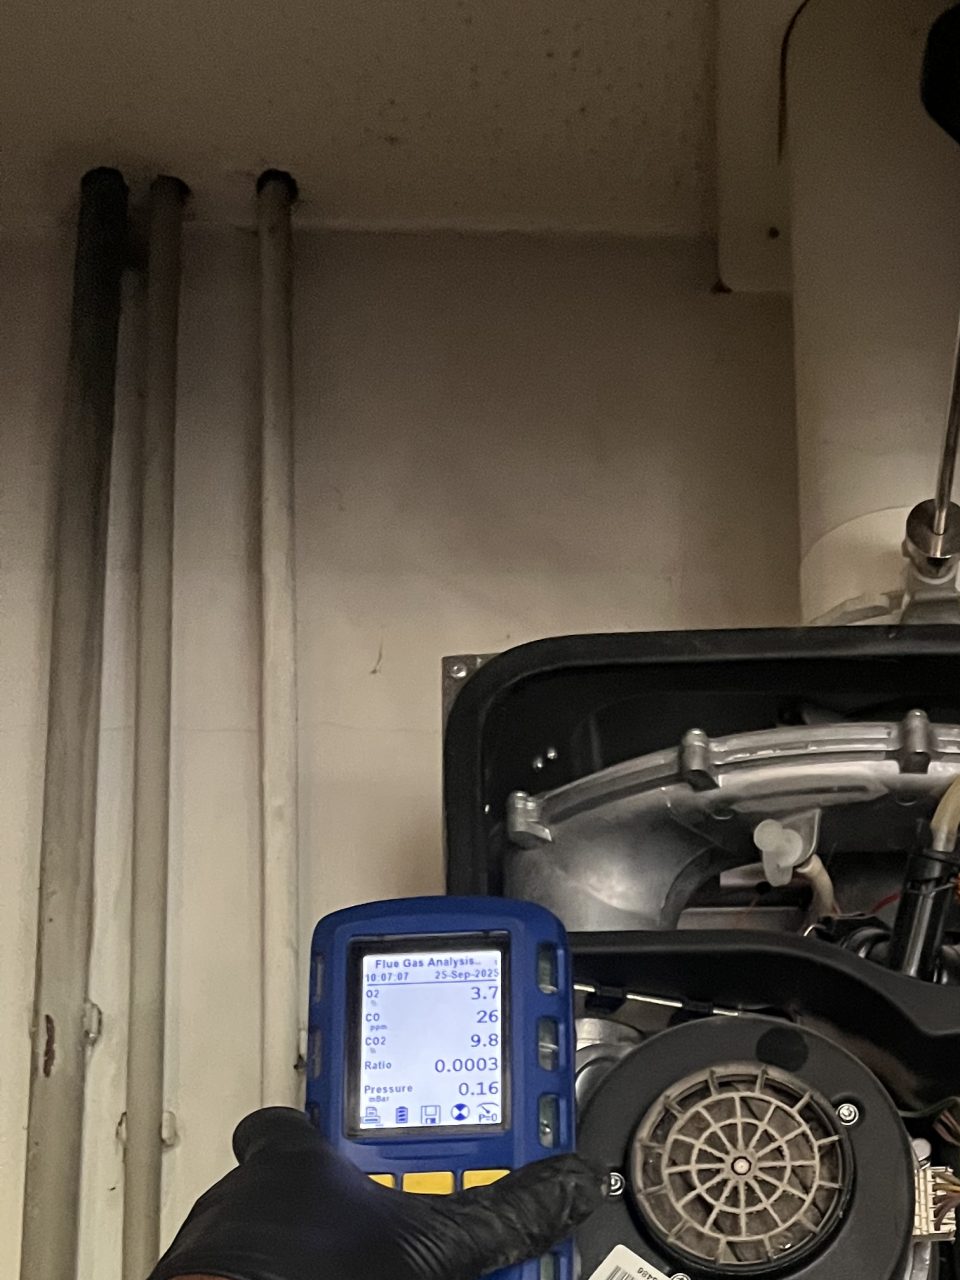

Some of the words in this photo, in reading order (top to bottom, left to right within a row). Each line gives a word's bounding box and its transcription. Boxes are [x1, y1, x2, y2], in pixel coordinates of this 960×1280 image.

[375, 959, 399, 969] Flue
[403, 958, 424, 968] Gas
[435, 968, 500, 981] 25-Sep-2025
[365, 989, 380, 998] O2
[471, 985, 499, 1000] 3.7
[365, 1013, 380, 1022] CO
[476, 1009, 499, 1024] 26
[365, 1036, 386, 1046] CO2
[470, 1033, 499, 1048] 9.8
[364, 1060, 392, 1070] Ratio
[434, 1057, 499, 1073] 0.0003
[364, 1084, 413, 1094] Pressure
[458, 1081, 499, 1096] 0.16
